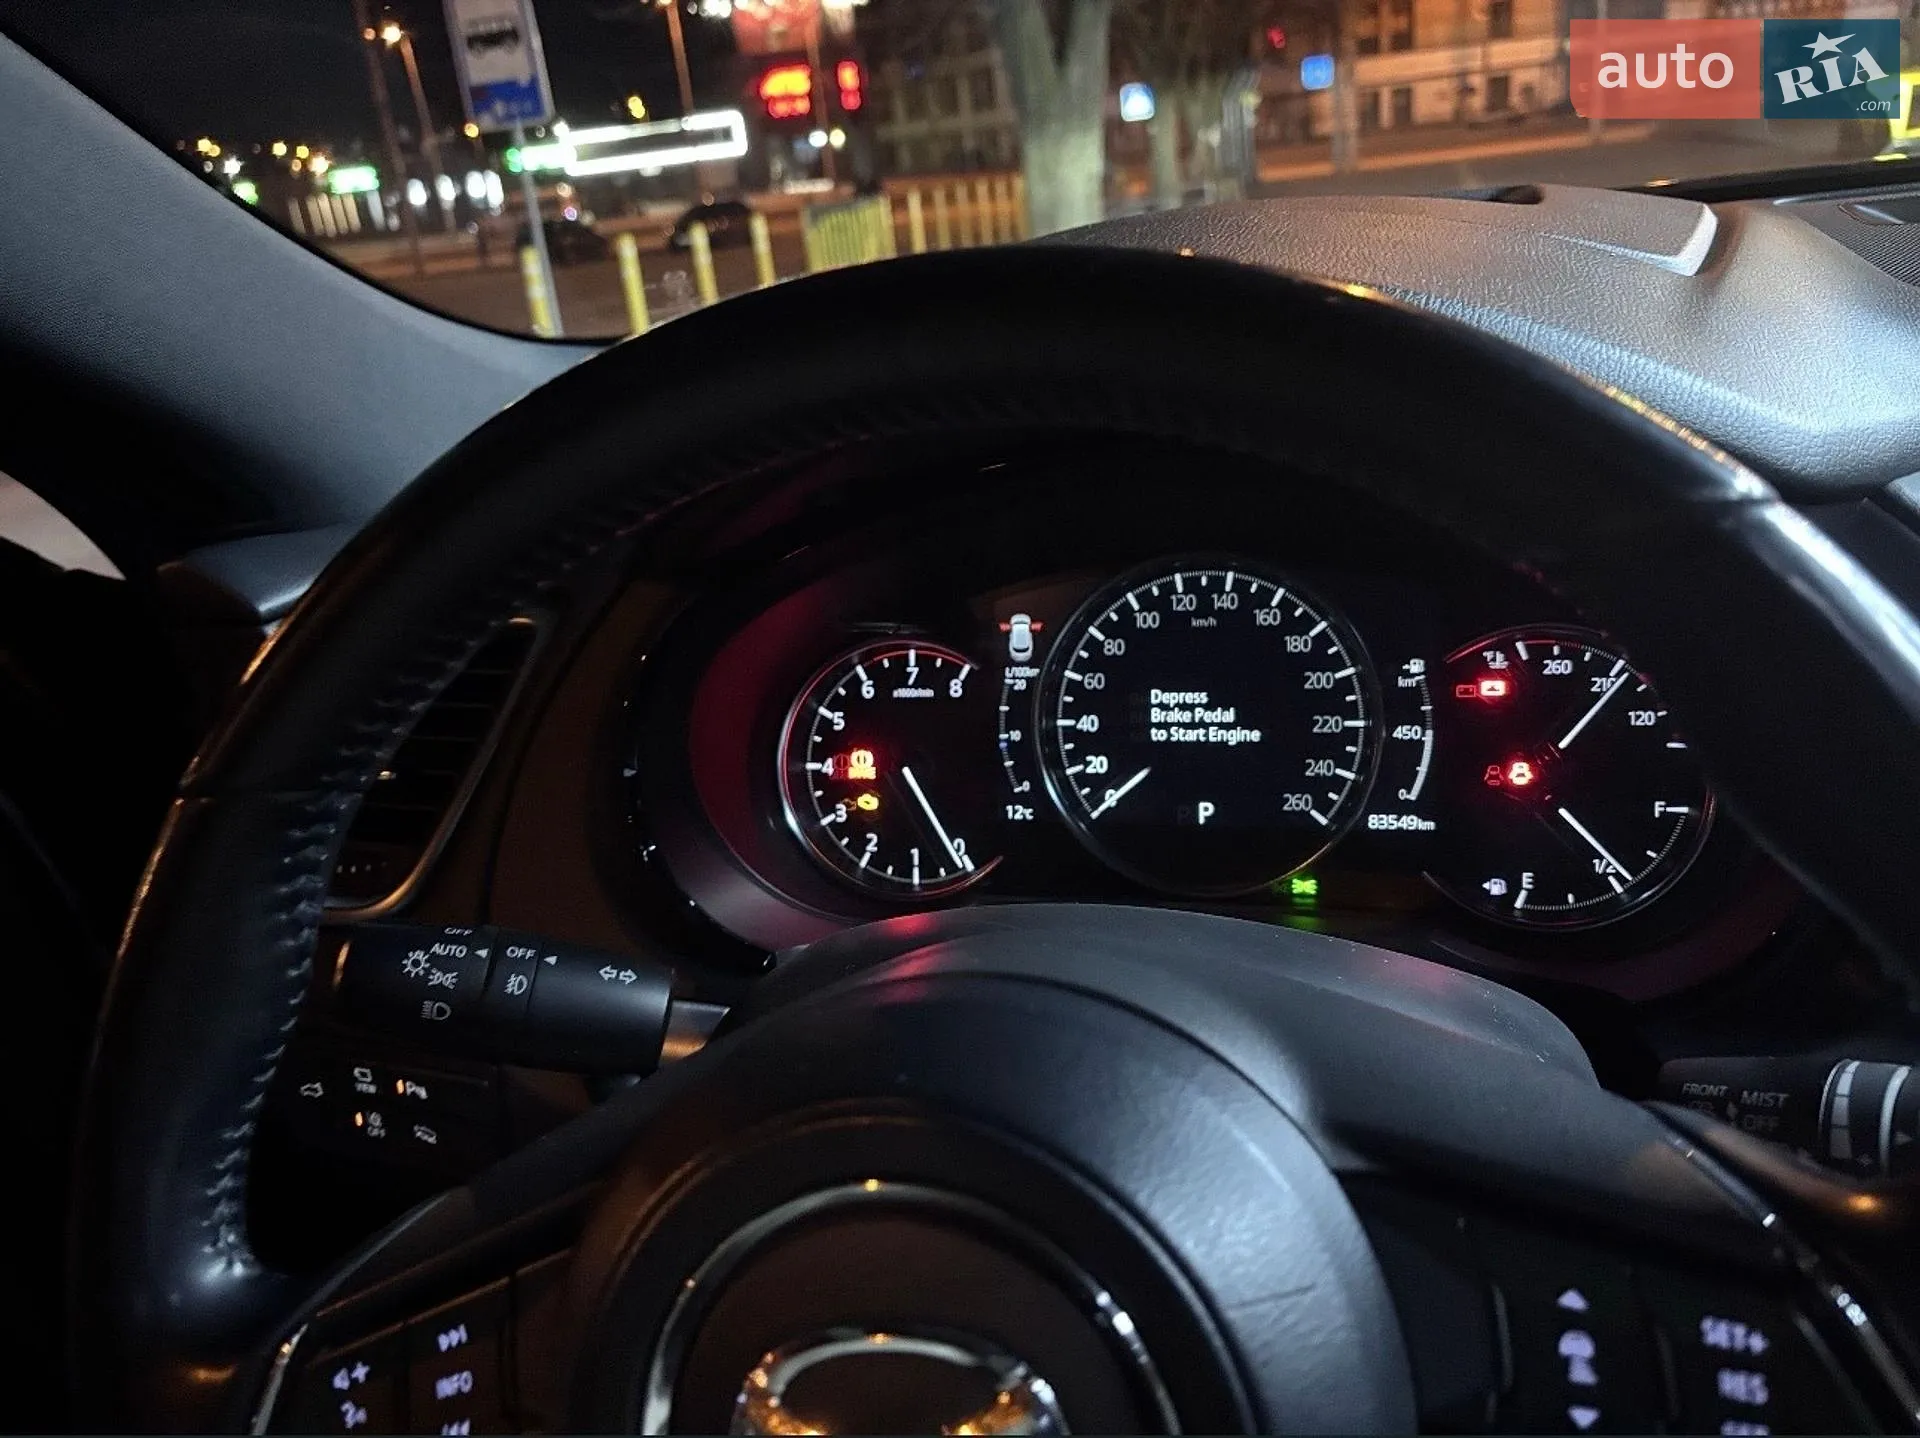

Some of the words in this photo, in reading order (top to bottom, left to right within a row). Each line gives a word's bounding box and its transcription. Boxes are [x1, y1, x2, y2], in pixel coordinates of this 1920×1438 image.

[1171, 594, 1196, 611] 120
[1212, 593, 1238, 610] 140
[1135, 612, 1160, 628] 100
[1191, 617, 1217, 628] km/h
[1254, 609, 1280, 625] 160
[1104, 639, 1125, 656] 80
[1285, 636, 1311, 652] 180
[1543, 660, 1572, 675] 260
[906, 667, 920, 686] 7
[1014, 679, 1027, 690] 20
[1084, 673, 1105, 690] 60
[1304, 673, 1334, 690] 200
[1398, 676, 1416, 687] km
[861, 681, 875, 699] 6
[949, 679, 963, 698] 8
[1151, 689, 1208, 708] Depress
[832, 712, 845, 731] 5
[1076, 715, 1099, 732] 40
[1151, 707, 1191, 723] Brake
[1195, 707, 1235, 723] Pedal
[1628, 711, 1656, 726] 120
[1312, 716, 1342, 733] 220
[1393, 726, 1422, 739] 450
[1010, 730, 1022, 742] 10
[1151, 726, 1168, 741] to
[1170, 726, 1205, 741] Start
[1209, 726, 1261, 745] Engine
[821, 757, 834, 776] 4
[1085, 756, 1108, 774] 20
[1305, 760, 1334, 776] 240
[1283, 795, 1312, 811] 260
[1655, 802, 1665, 817] F
[835, 804, 848, 822] 3
[1198, 802, 1214, 823] P
[866, 834, 878, 852] 2
[911, 848, 920, 866] 1
[1522, 873, 1533, 889] E
[430, 943, 467, 958] AUTO
[506, 946, 536, 960] OFF
[1682, 1082, 1729, 1097] FRONT
[1740, 1090, 1790, 1108] MIST
